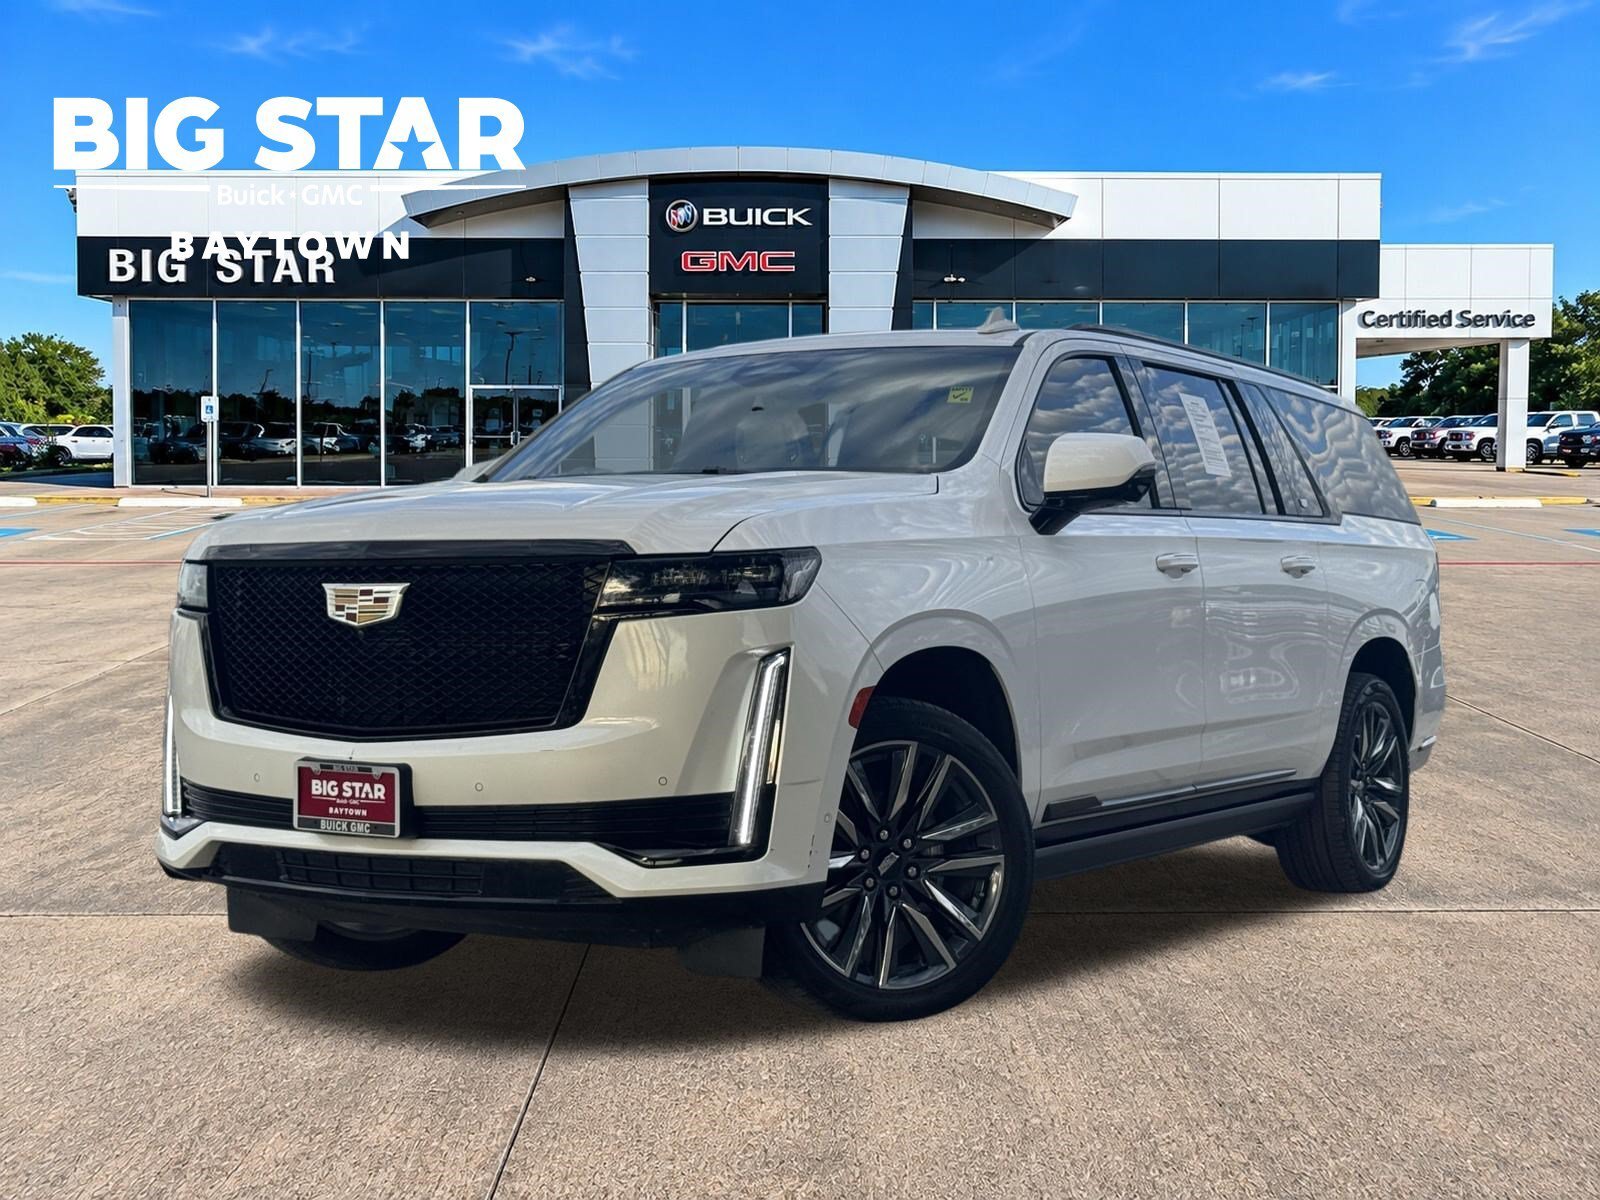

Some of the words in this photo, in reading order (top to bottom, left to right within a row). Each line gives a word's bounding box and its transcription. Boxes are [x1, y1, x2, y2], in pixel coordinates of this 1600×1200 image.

[703, 208, 813, 226] BUICK
[108, 248, 187, 283] BIG
[216, 249, 336, 283] STAR
[681, 251, 795, 272] GMC
[1358, 309, 1453, 328] Certified
[1456, 309, 1536, 328] Service
[311, 779, 339, 796] BIG
[342, 781, 386, 800] STAR
[328, 806, 368, 816] BAYTOWN
[320, 819, 348, 832] BUICK
[350, 821, 371, 833] GMC
